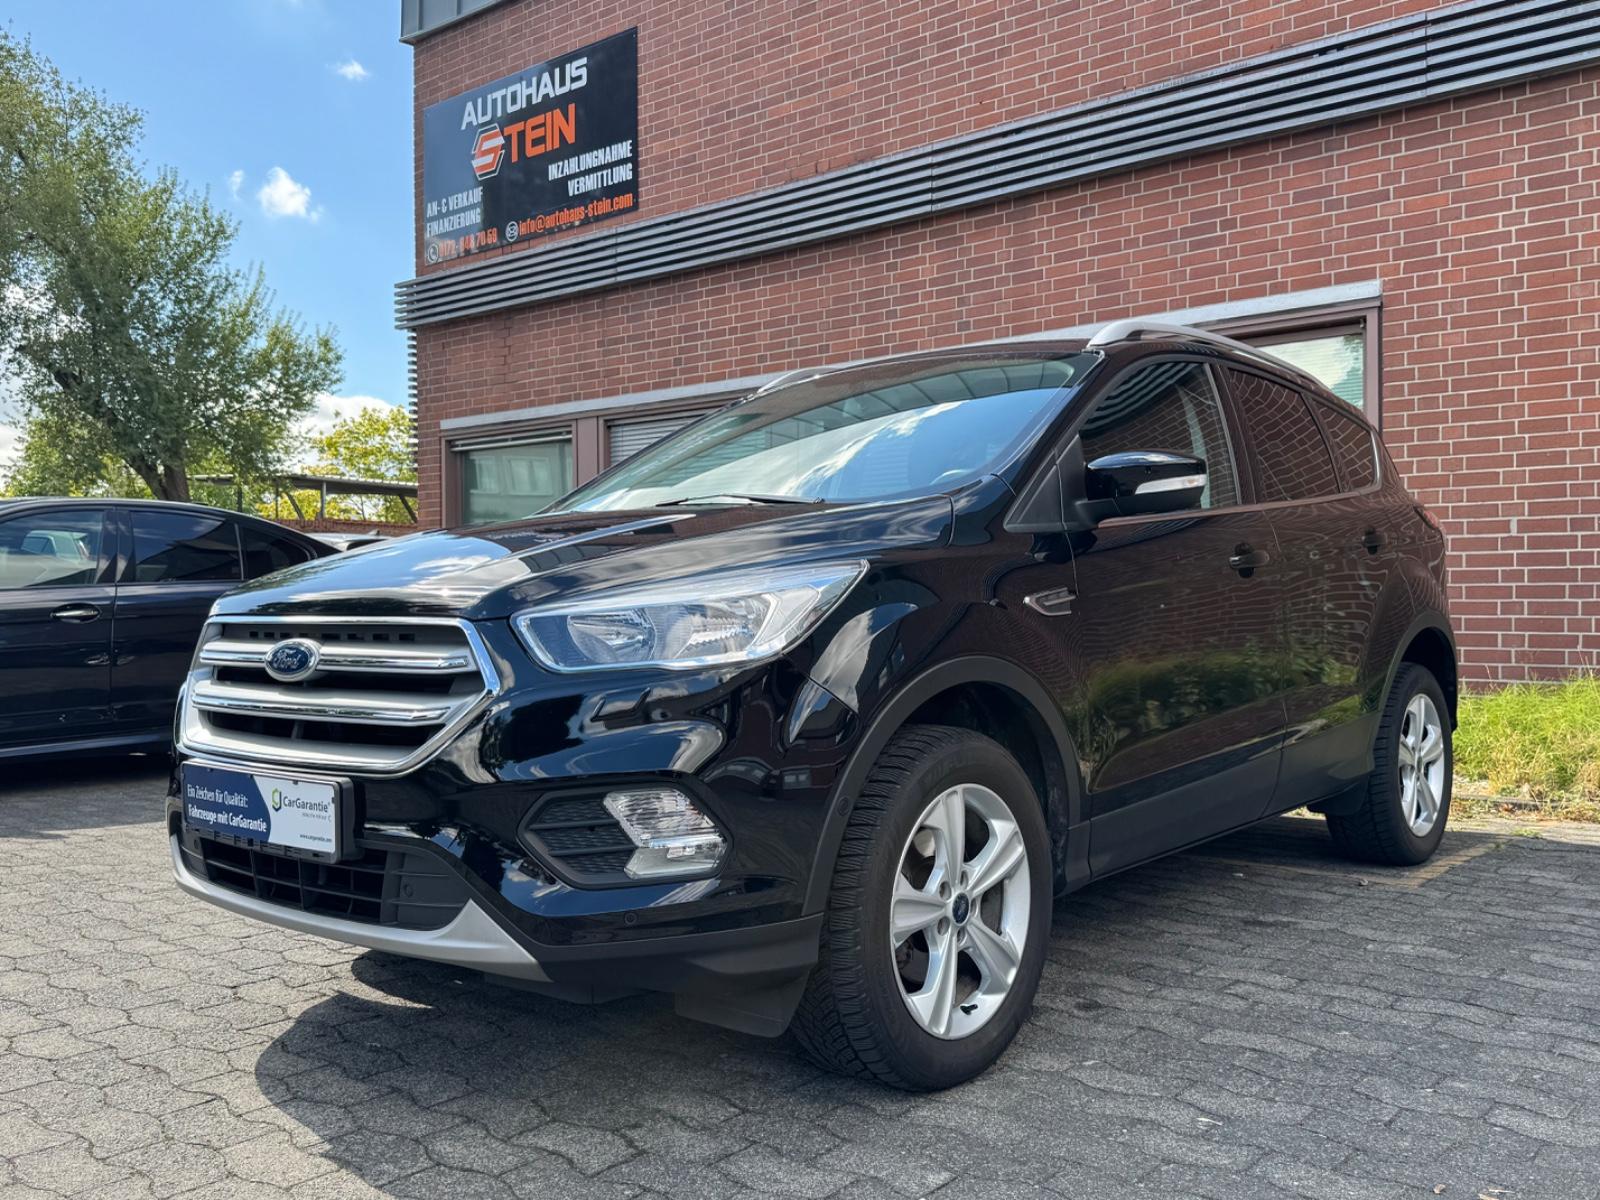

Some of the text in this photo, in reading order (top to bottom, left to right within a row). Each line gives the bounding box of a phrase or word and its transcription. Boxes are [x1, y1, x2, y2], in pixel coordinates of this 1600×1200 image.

[461, 57, 588, 130] AUTOHAUS
[471, 103, 576, 180] STEIN
[548, 140, 633, 181] INZAHLUNGNAHME
[567, 163, 633, 197] VERMITTLUNG
[448, 186, 484, 211] VERKAUF
[519, 193, 633, 236] info@autohaus-stein.com
[426, 208, 481, 238] FINANZIERUNG
[187, 784, 248, 808] Ein Zeichen für Qualität:
[188, 804, 267, 833] Fahrzeuge mit CarGarantie
